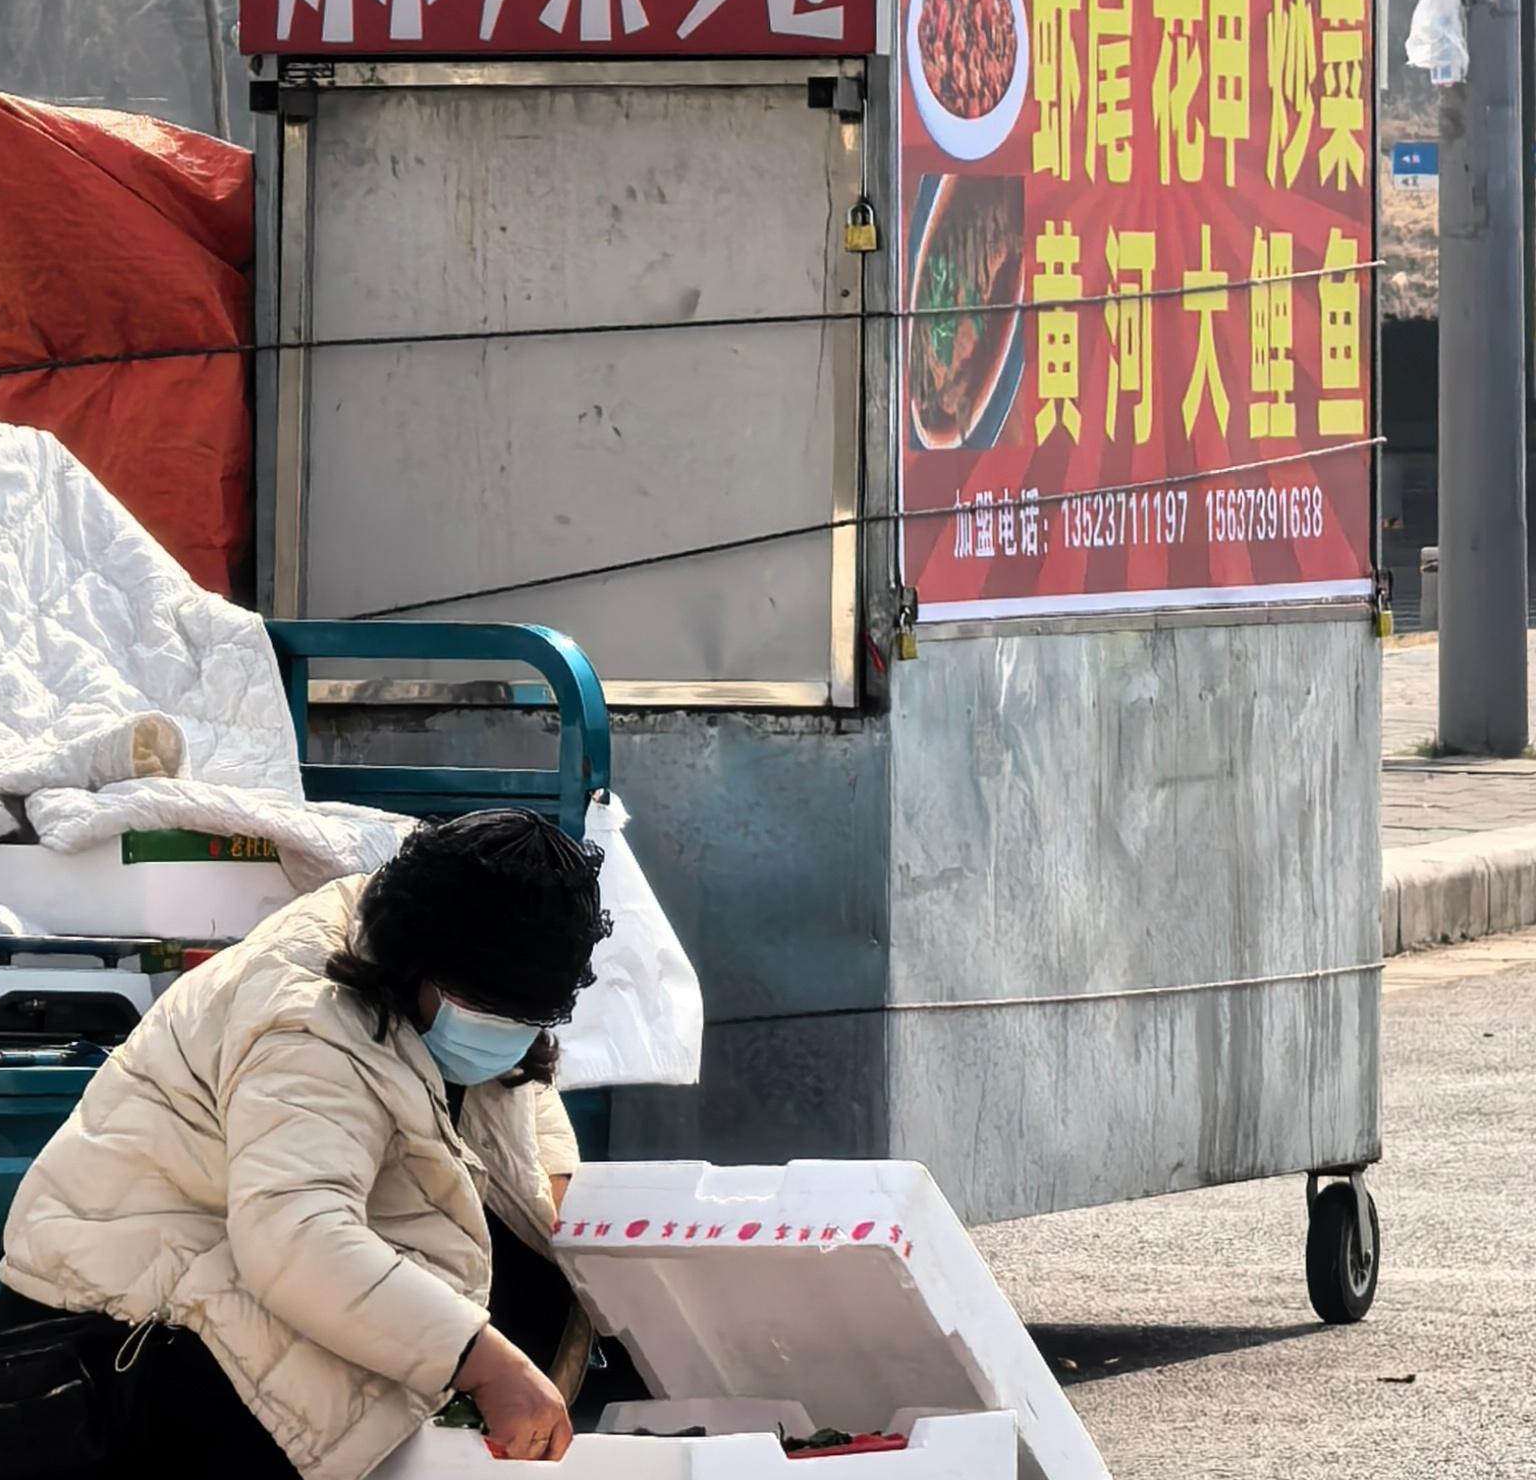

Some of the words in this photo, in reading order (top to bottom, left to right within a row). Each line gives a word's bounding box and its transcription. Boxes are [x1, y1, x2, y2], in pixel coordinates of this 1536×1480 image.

[1033, 220, 1365, 445] 黄河大鲤鱼
[1062, 491, 1188, 548] 13523711197
[1205, 485, 1323, 542] 15637391638
